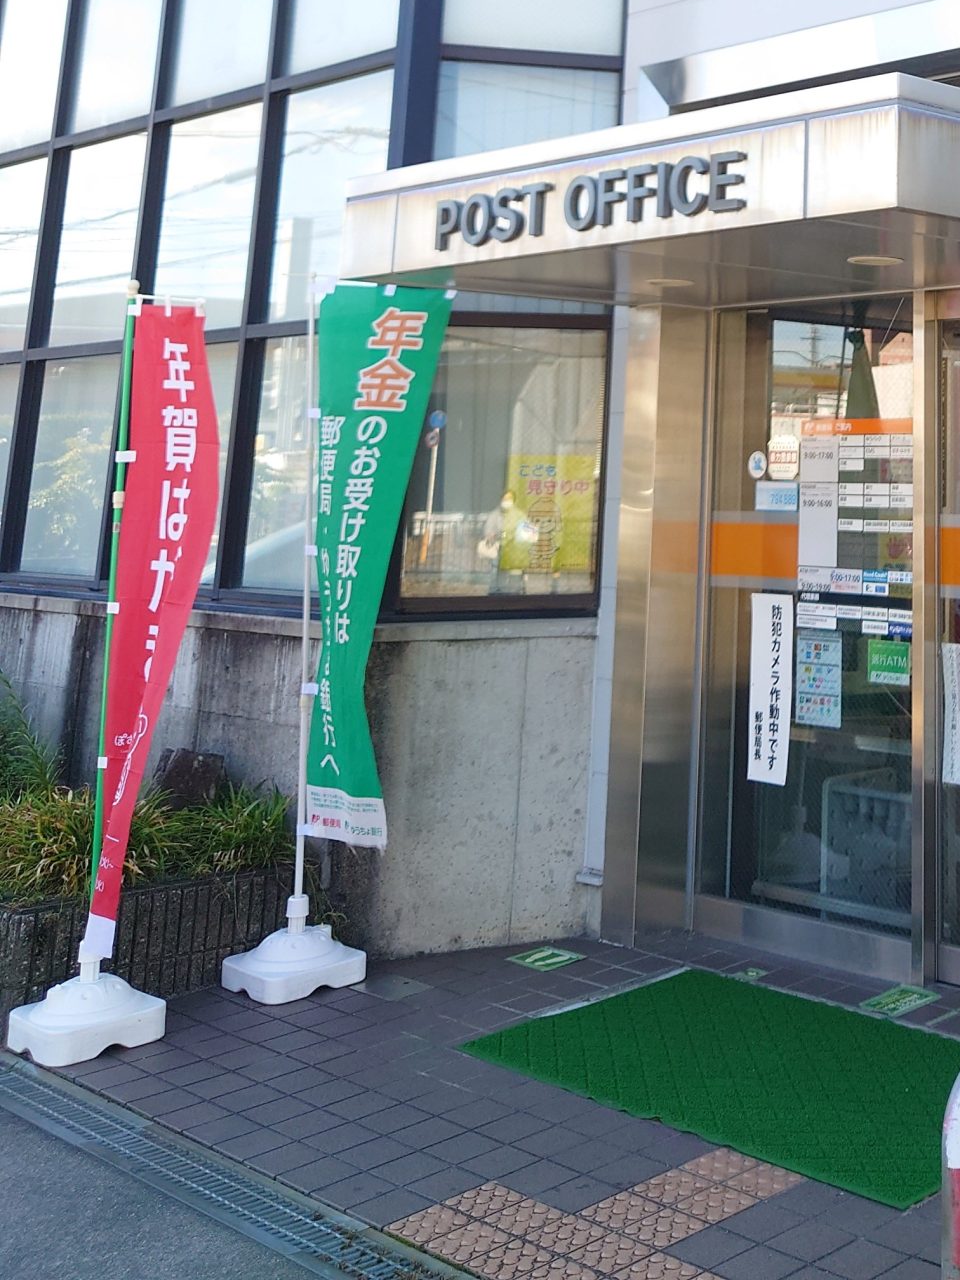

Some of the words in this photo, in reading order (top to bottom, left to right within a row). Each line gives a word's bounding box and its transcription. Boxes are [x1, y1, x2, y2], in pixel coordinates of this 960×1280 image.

[435, 182, 554, 251] POST
[564, 151, 747, 231] OFFICE
[519, 464, 557, 477] こども
[527, 479, 589, 495] 見守り中
[767, 604, 783, 770] 防犯カメラ作動中です
[754, 711, 764, 760] 郵便局長
